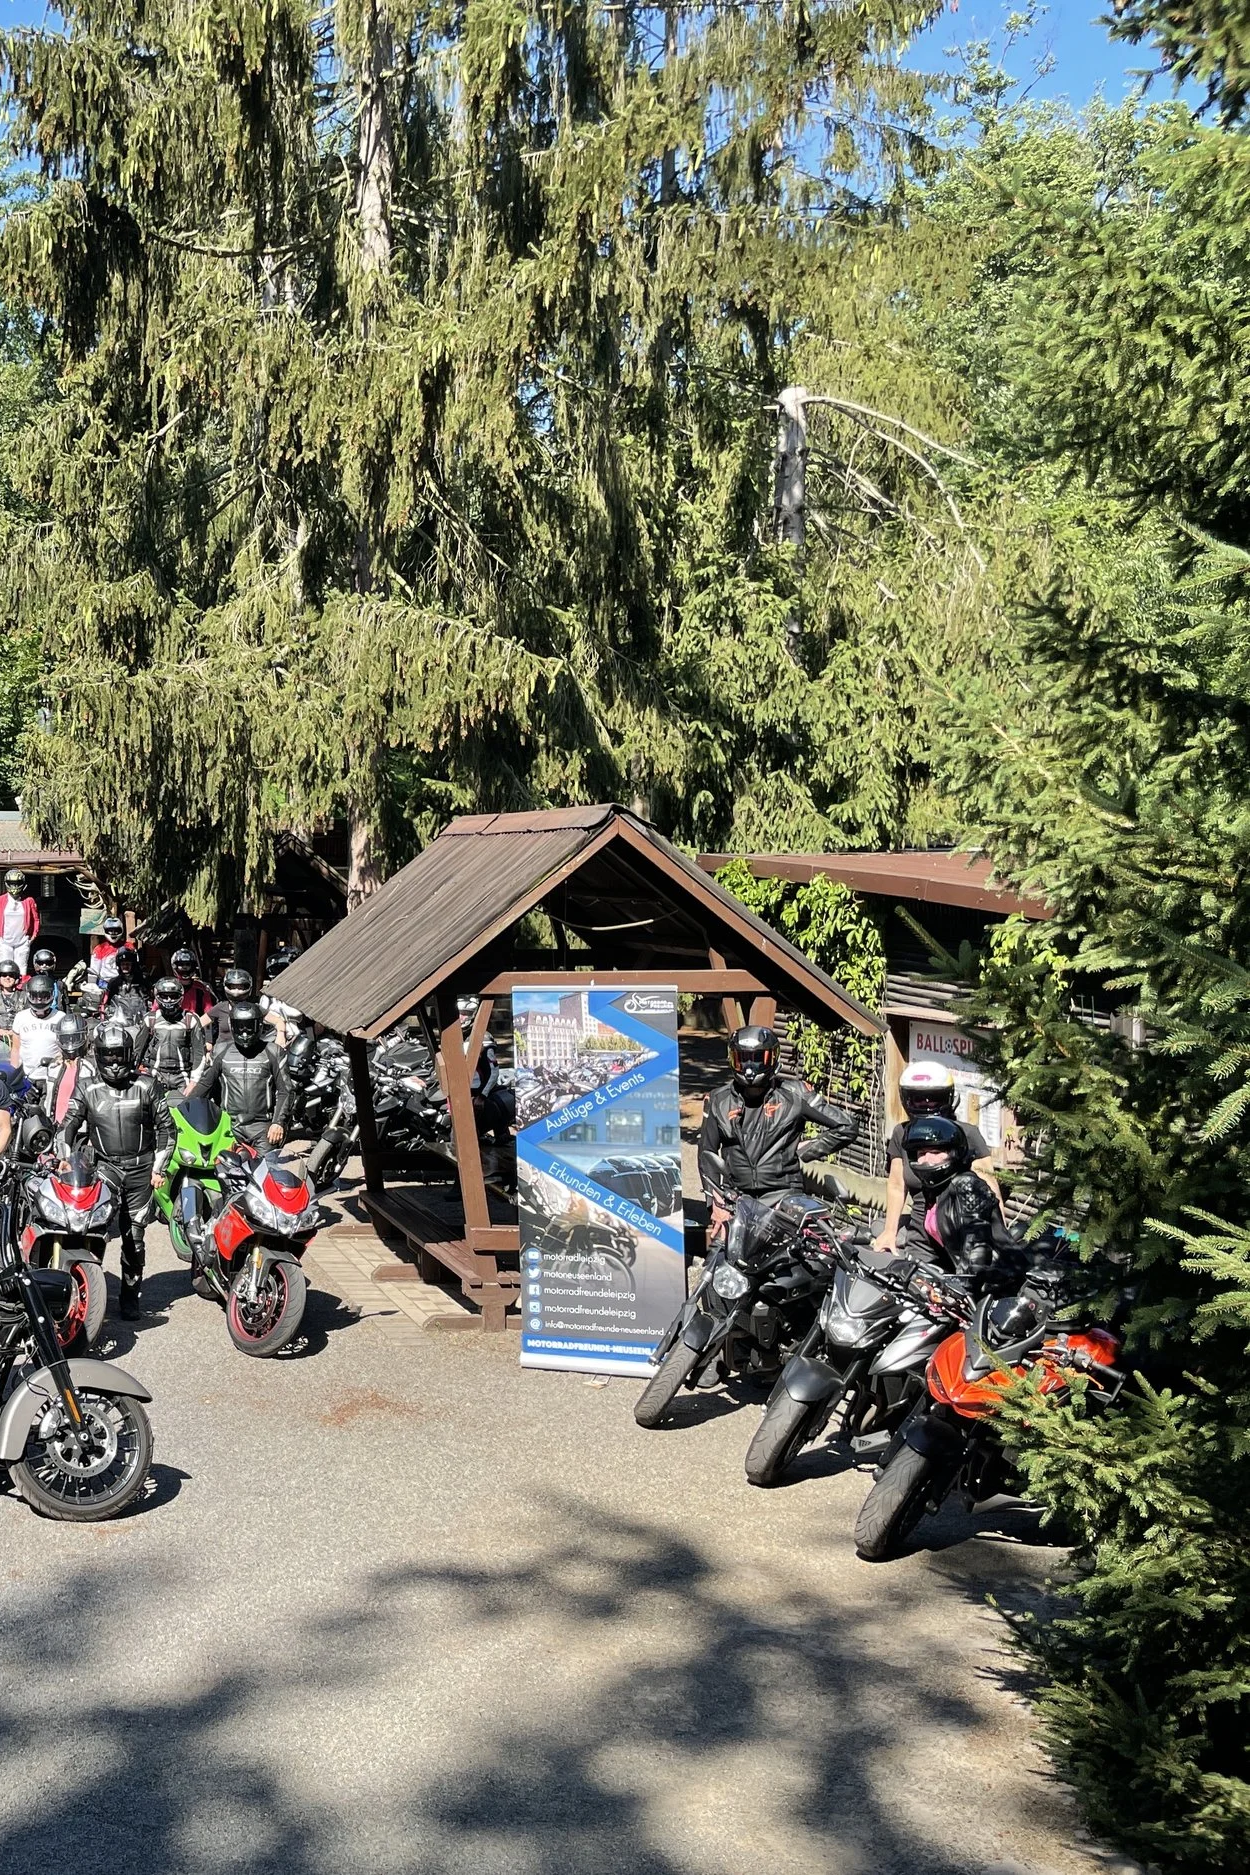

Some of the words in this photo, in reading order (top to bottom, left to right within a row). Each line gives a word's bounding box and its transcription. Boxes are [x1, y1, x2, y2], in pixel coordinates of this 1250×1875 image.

[545, 1099, 594, 1132] Ausflüge
[595, 1091, 607, 1105] &
[606, 1072, 645, 1098] Events
[548, 1161, 601, 1201] Erkunden
[603, 1195, 614, 1208] &
[617, 1202, 662, 1236] Erleben
[543, 1253, 606, 1265] motorradleipzig
[543, 1270, 612, 1281] motoneuseenland
[544, 1287, 636, 1301] motorradfreundeleipzig
[544, 1304, 637, 1320] motorradfreundeleipzig
